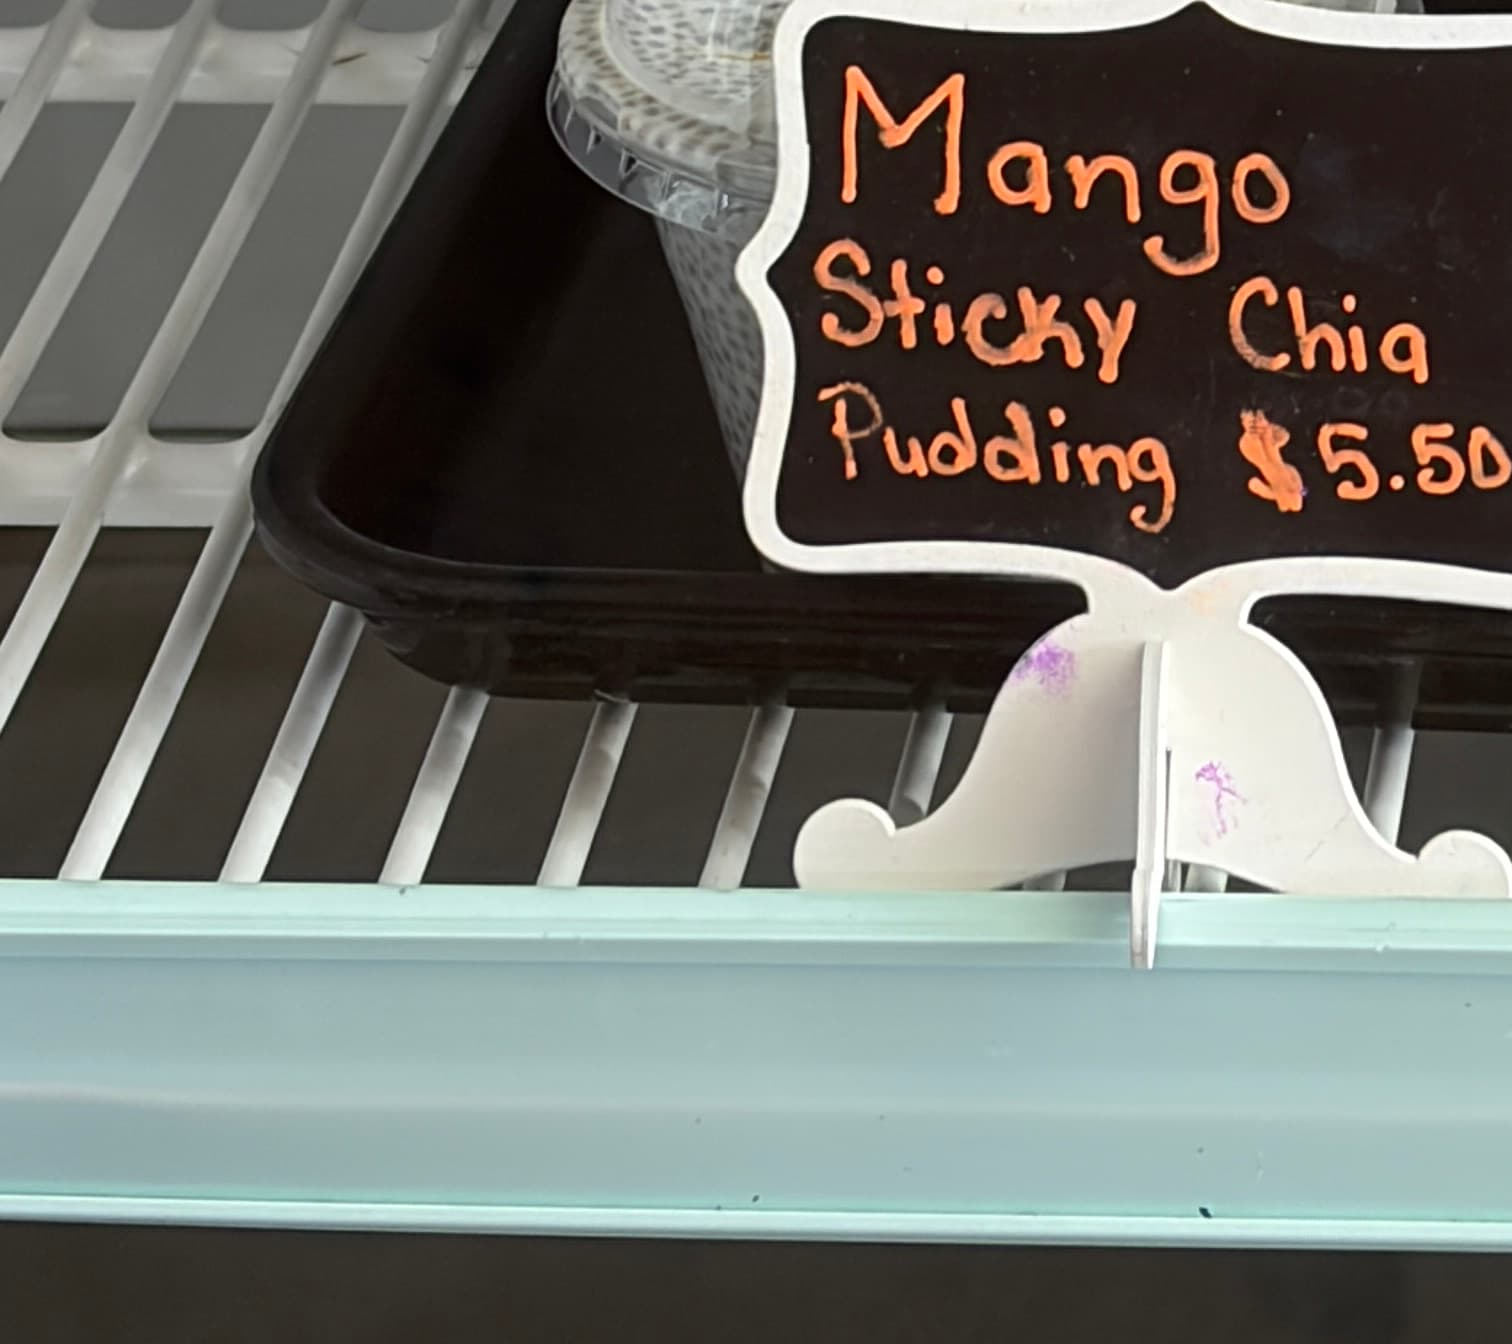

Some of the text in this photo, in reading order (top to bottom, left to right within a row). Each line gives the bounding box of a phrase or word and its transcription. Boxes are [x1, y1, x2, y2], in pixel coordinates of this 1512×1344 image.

[842, 66, 1290, 277] Mango
[814, 239, 1429, 384] Sticky Chia
[818, 383, 1512, 533] Pudding $5.50
